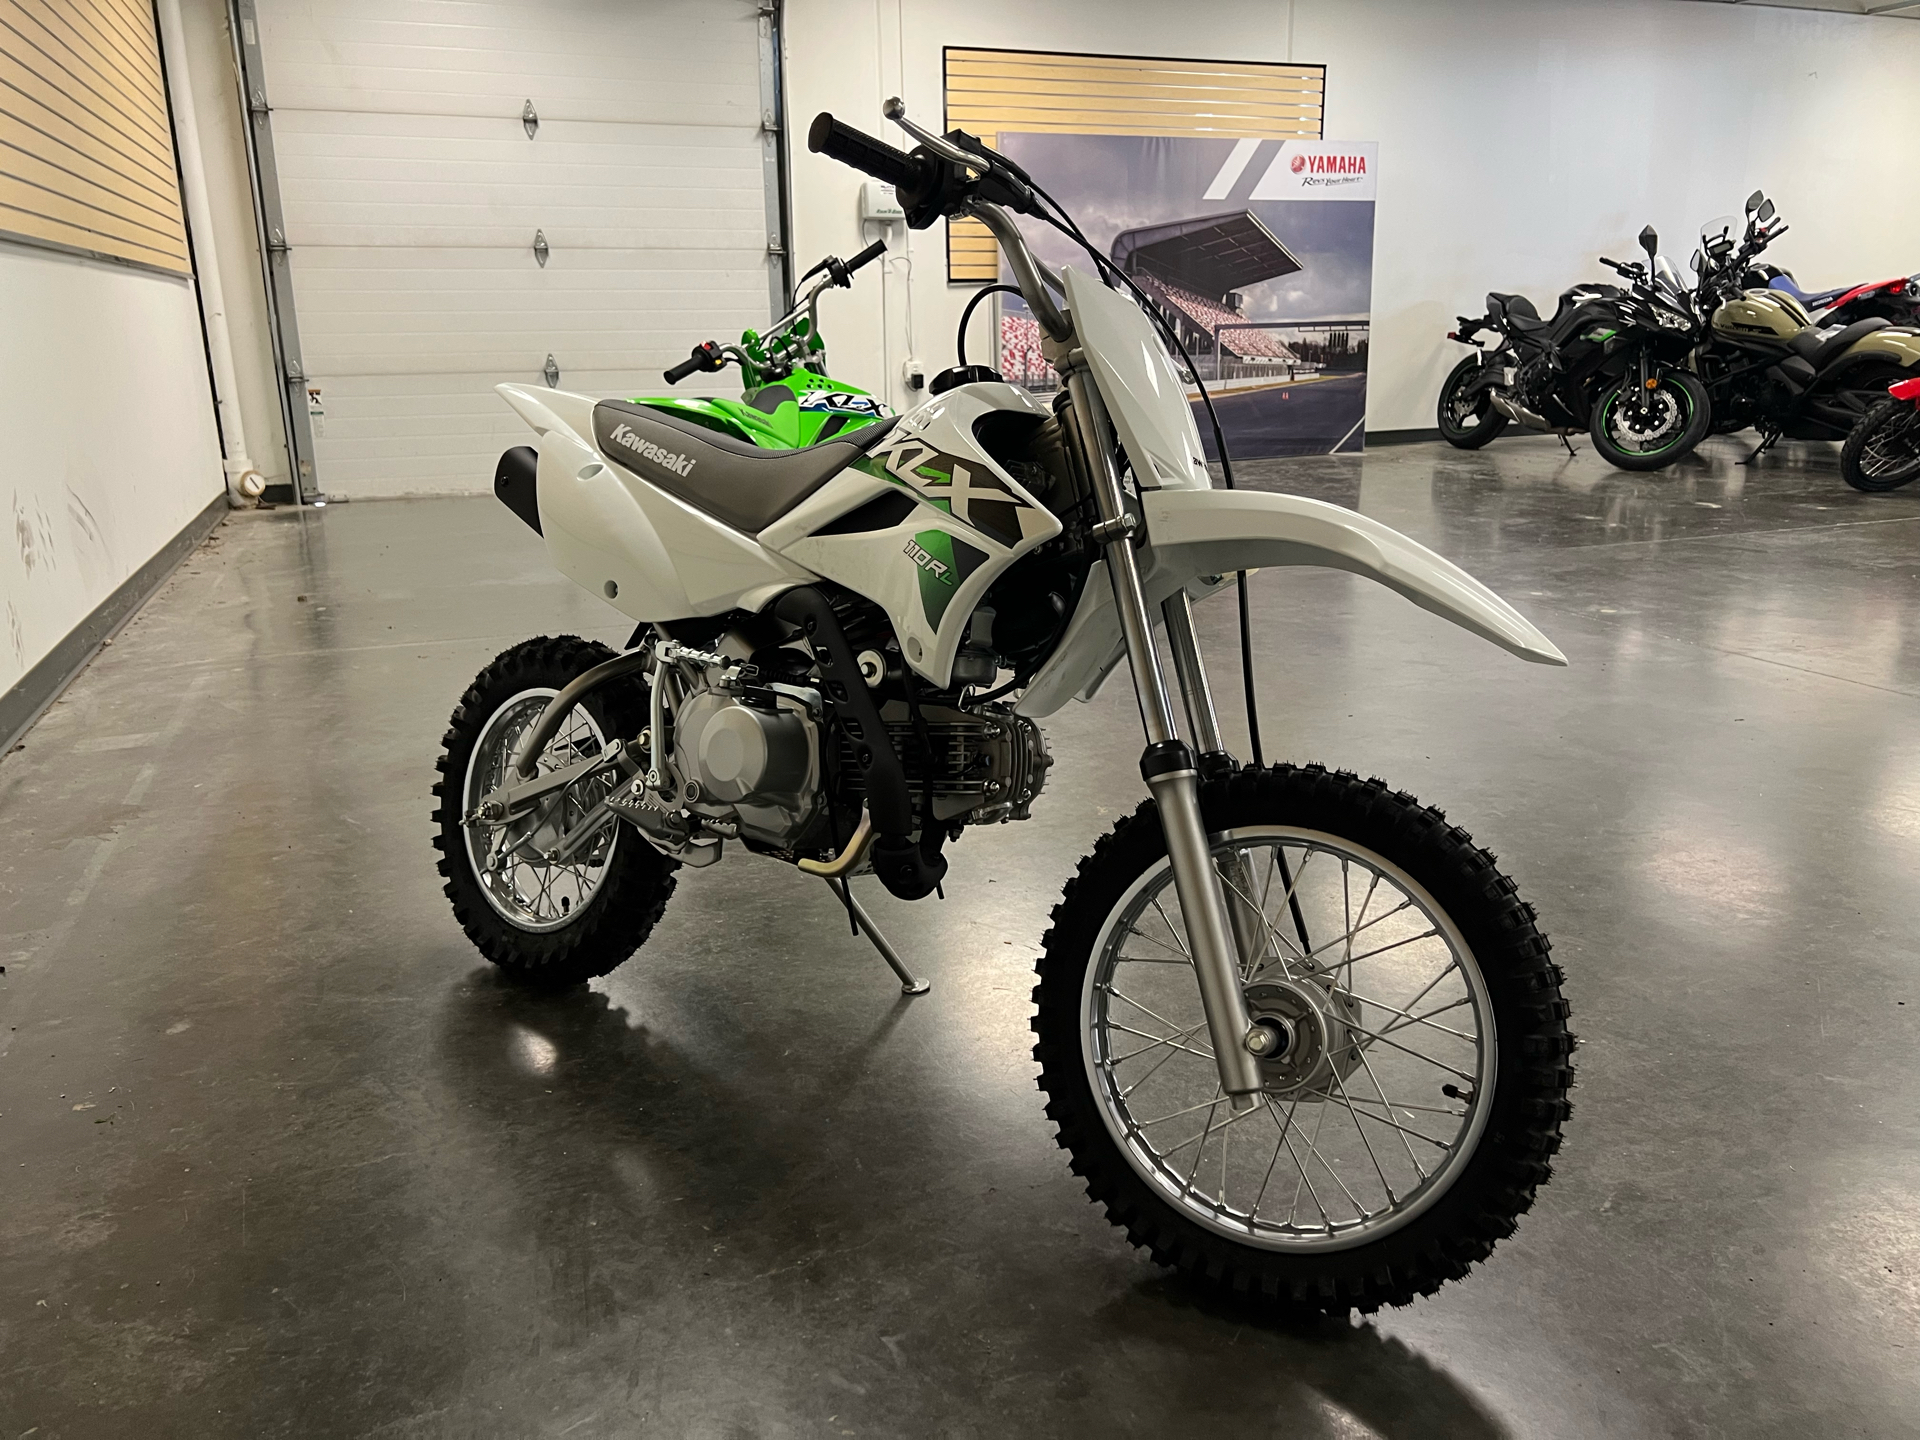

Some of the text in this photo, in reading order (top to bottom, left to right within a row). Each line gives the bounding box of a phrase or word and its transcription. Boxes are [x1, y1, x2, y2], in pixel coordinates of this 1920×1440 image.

[1308, 155, 1366, 174] YAMAHA
[1812, 296, 1834, 306] HONDA
[609, 423, 697, 478] Kawasaki
[865, 426, 1023, 528] KLX
